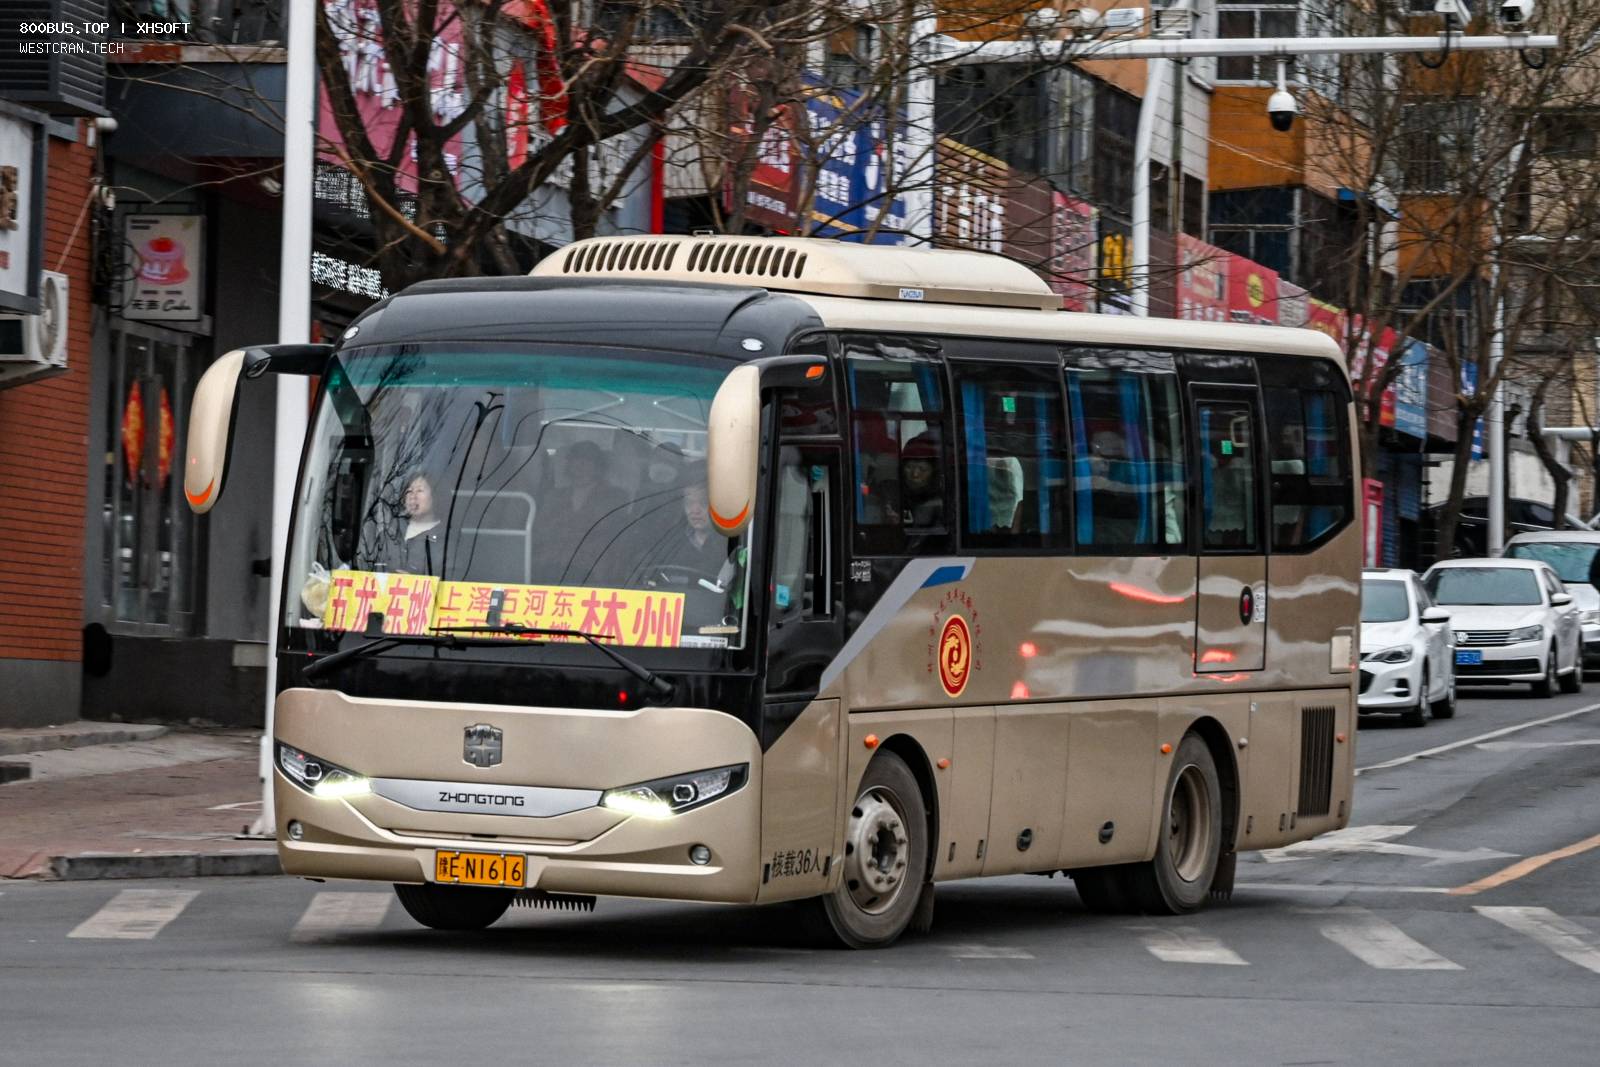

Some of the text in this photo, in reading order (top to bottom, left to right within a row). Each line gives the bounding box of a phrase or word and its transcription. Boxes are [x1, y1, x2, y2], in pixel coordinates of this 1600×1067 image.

[577, 590, 682, 648] 林州
[439, 791, 525, 807] ZHONGTONG
[772, 848, 820, 878] 核载36人
